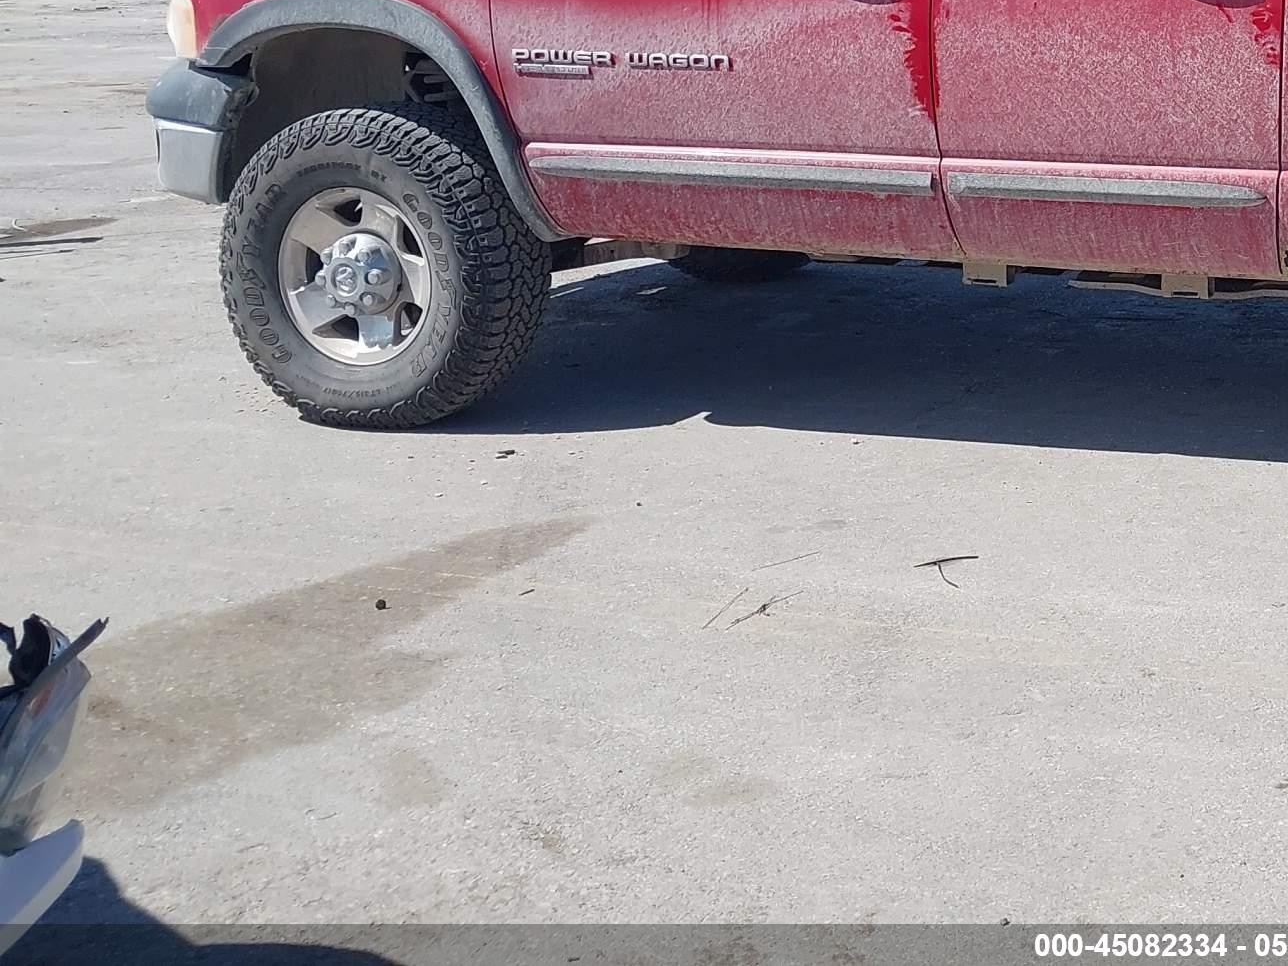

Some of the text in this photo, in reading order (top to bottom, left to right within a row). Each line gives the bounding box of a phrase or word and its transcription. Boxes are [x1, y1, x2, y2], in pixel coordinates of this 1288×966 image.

[512, 48, 730, 70] POWER WAGON
[238, 183, 292, 364] GOODYEAR
[402, 192, 455, 378] GOODYEAR
